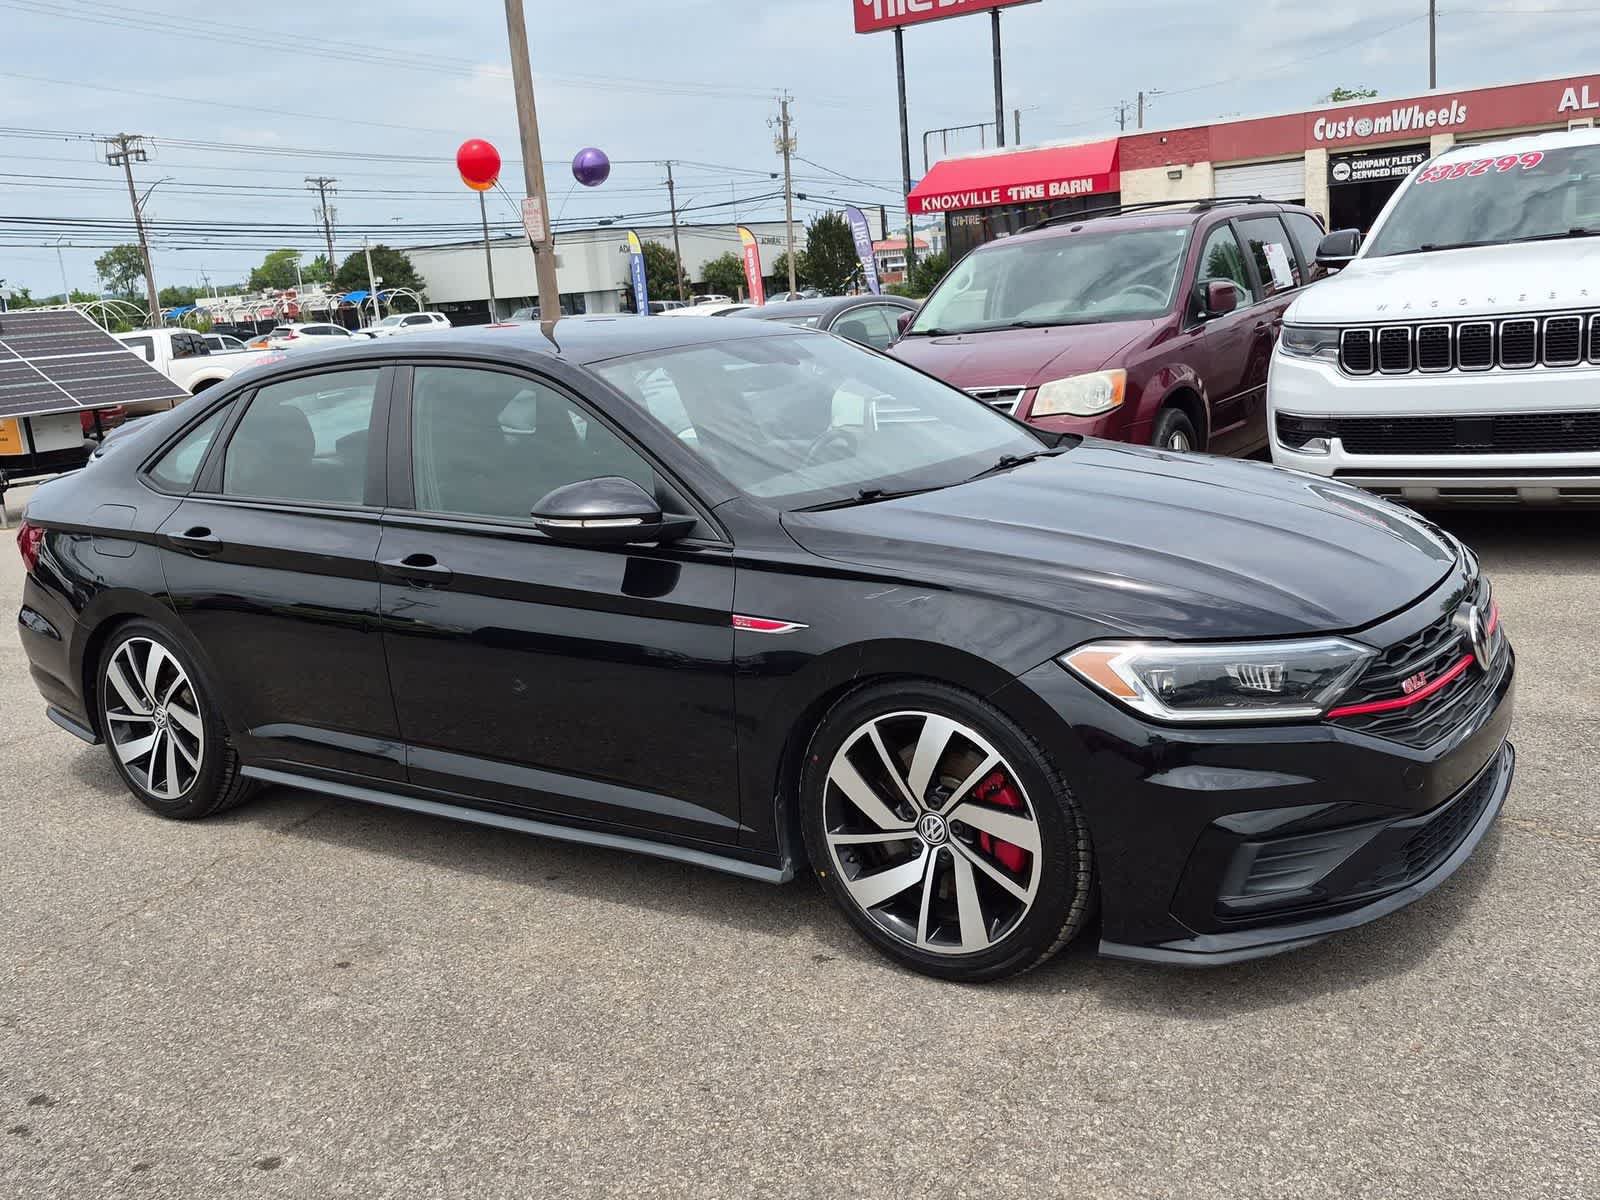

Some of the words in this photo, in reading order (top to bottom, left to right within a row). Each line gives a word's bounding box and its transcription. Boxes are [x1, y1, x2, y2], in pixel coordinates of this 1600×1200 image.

[1352, 158, 1391, 170] COMPANY
[1352, 168, 1391, 180] SERVICED
[921, 189, 1000, 211] KNOXVILLE
[1049, 178, 1093, 196] BARN
[1376, 289, 1589, 311] WAGONEER
